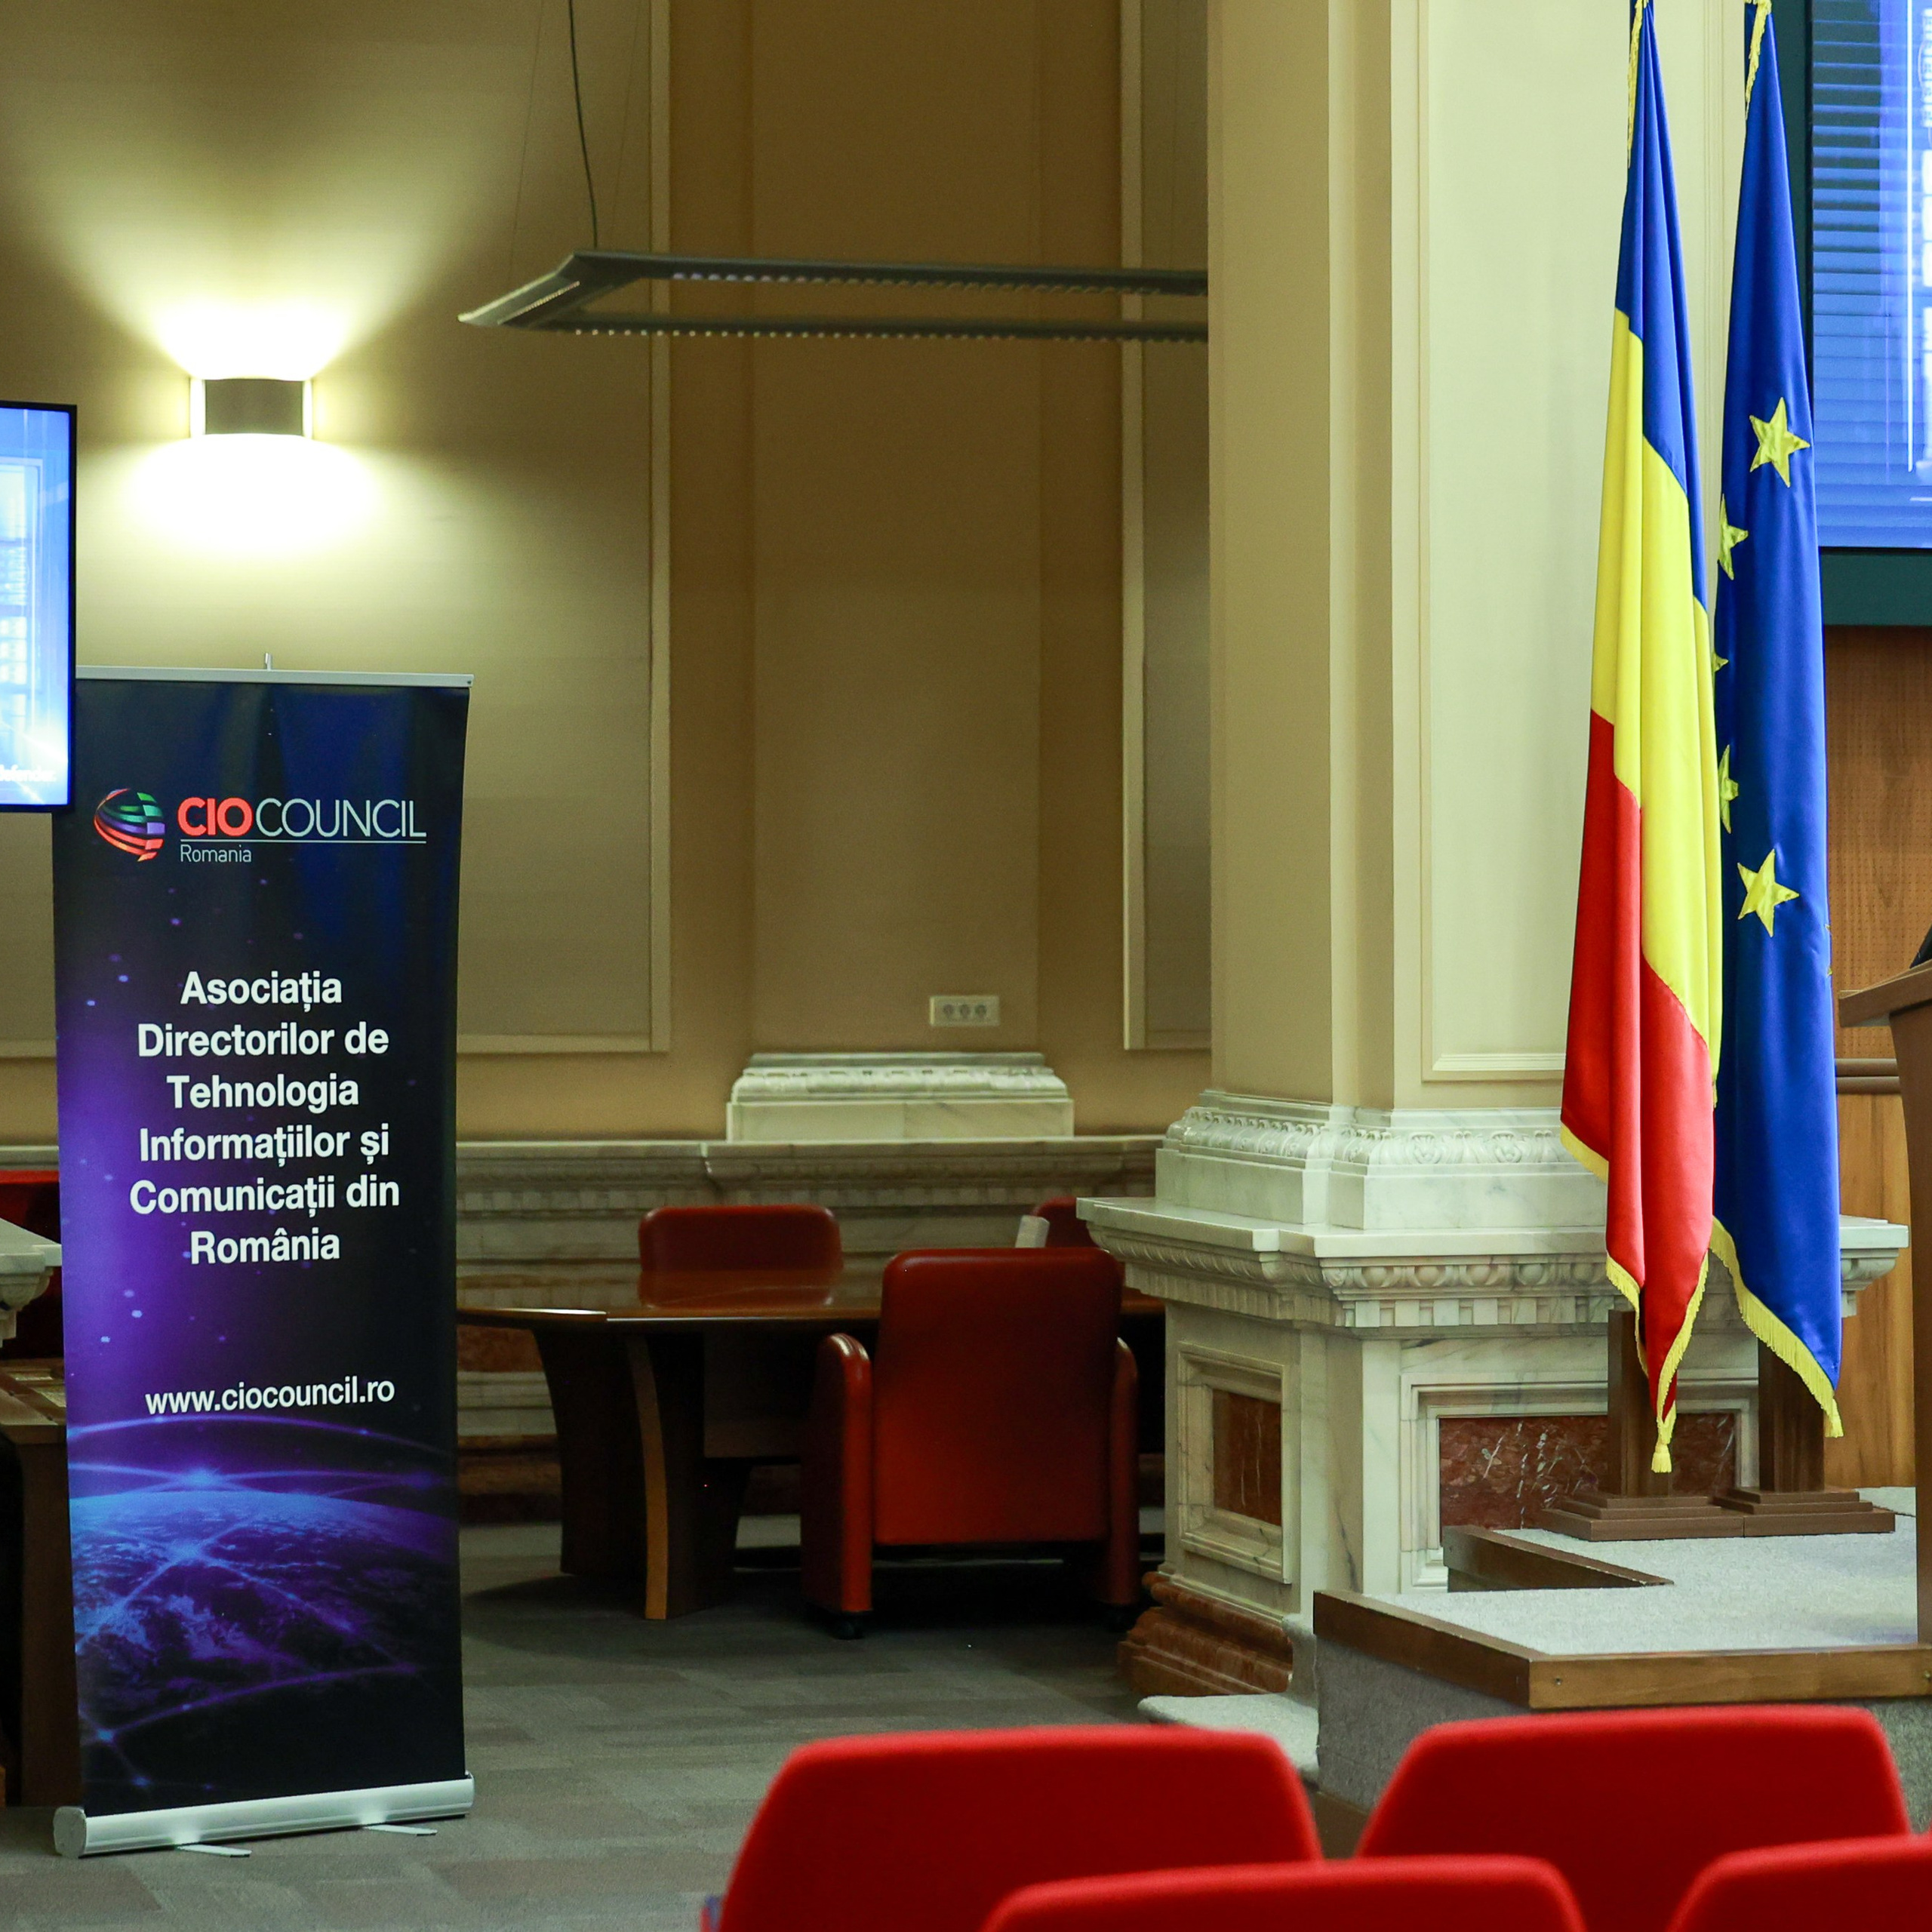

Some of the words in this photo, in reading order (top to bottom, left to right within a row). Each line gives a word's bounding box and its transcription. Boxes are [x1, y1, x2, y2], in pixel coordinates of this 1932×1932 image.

[180, 844, 252, 863] Romania
[180, 971, 342, 1012] Asociația
[138, 1023, 335, 1057] Directorilor
[345, 1022, 389, 1054] de
[167, 1073, 359, 1114] Tehnologia
[346, 1174, 399, 1208] din
[191, 1226, 340, 1265] România
[146, 1376, 395, 1415] www.ciocouncil.ro
